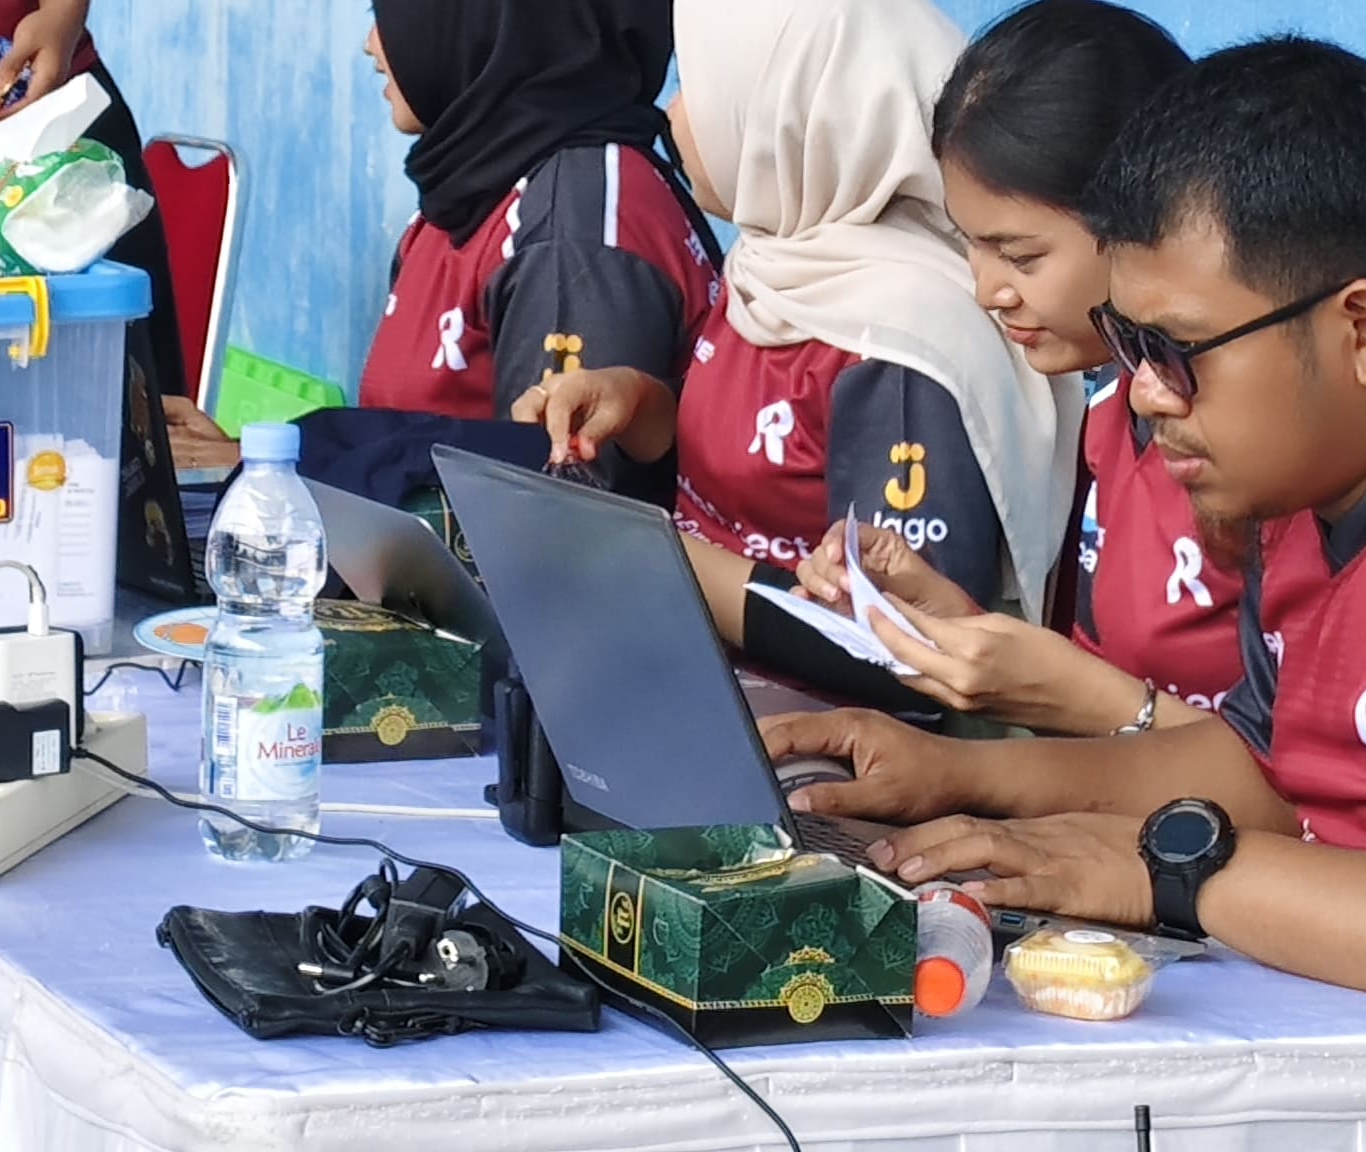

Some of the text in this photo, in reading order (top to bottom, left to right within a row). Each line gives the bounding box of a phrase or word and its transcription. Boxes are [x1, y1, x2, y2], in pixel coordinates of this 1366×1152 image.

[431, 306, 469, 371] R
[747, 399, 796, 466] R
[1166, 536, 1214, 607] R
[286, 722, 307, 742] Le
